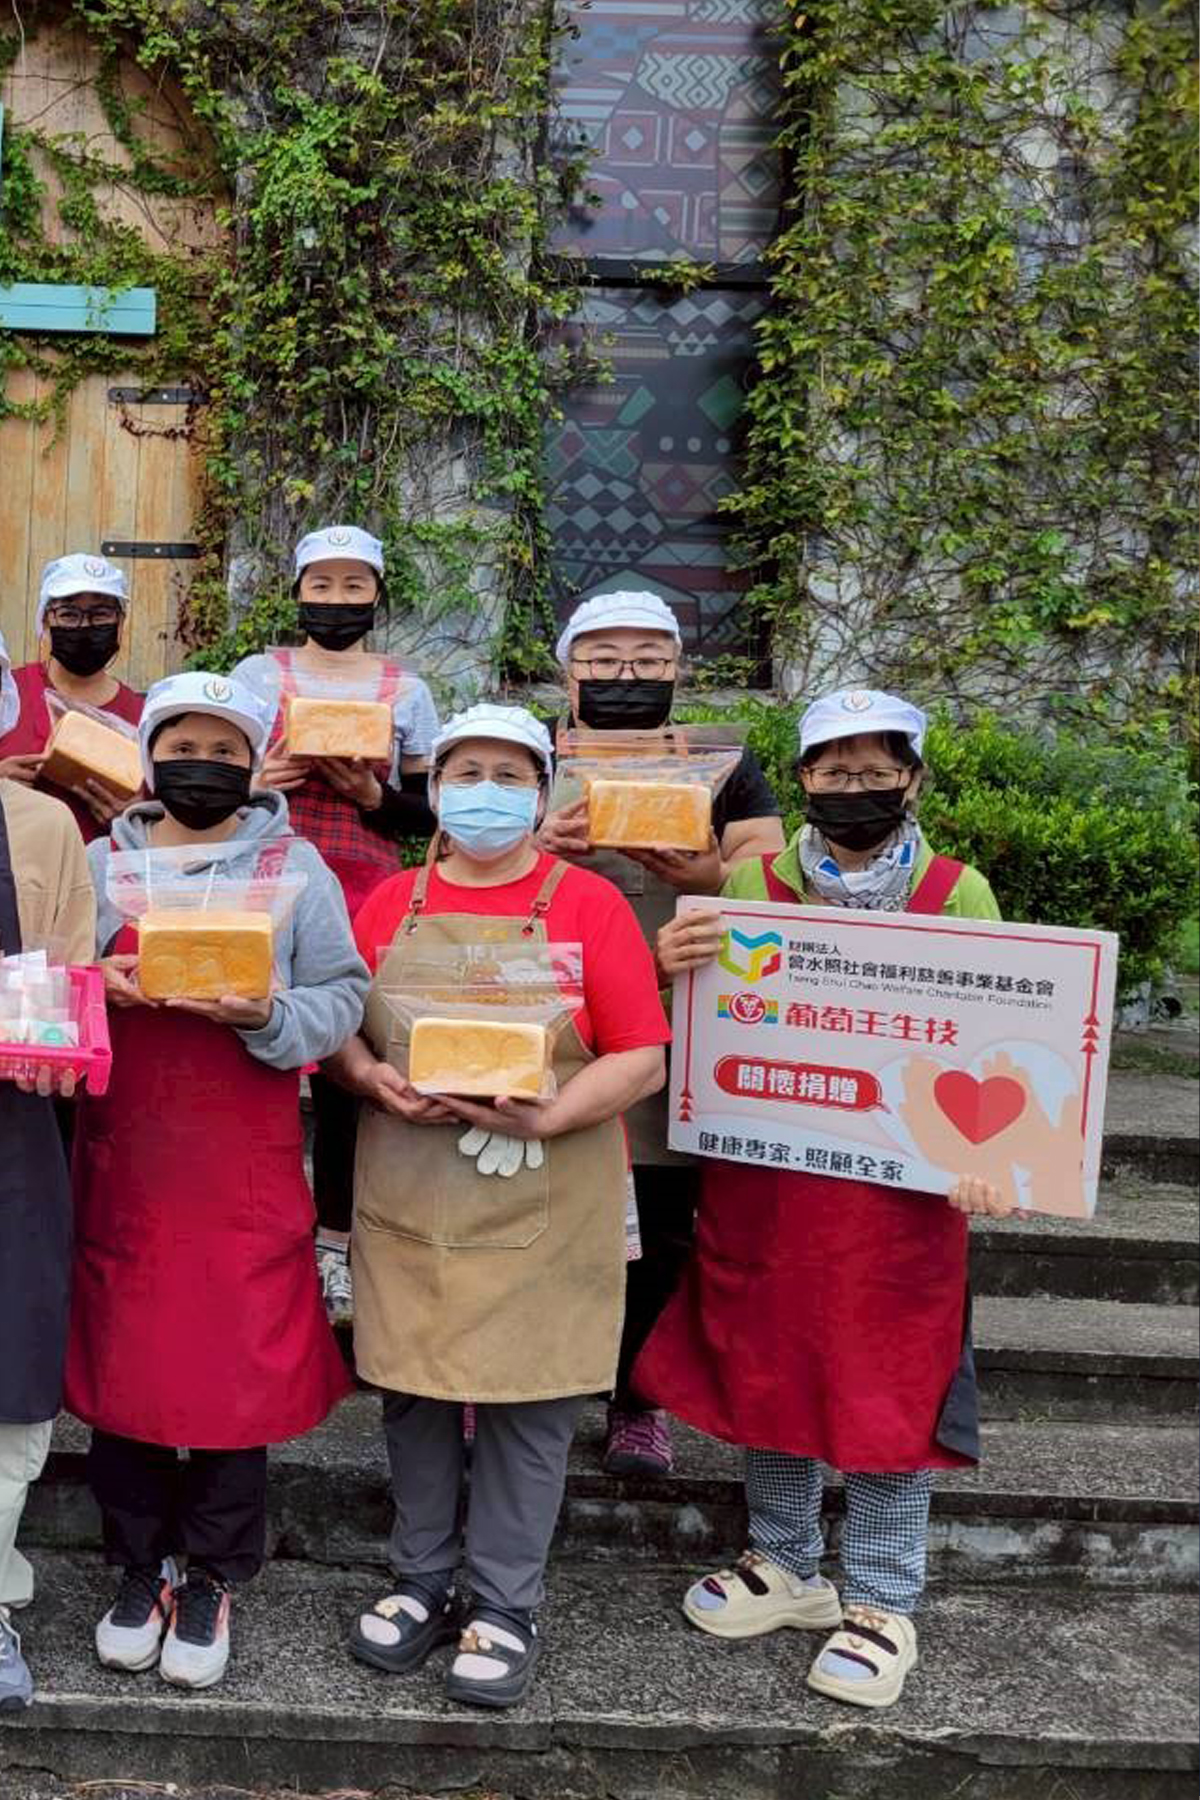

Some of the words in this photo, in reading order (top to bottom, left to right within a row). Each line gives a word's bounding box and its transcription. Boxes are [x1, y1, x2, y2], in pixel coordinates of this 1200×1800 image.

[788, 940, 842, 956] 財團法人
[880, 982, 924, 996] Welfare
[988, 994, 1052, 1009] Foundation
[784, 1001, 960, 1047] 葡萄王生技
[737, 1063, 859, 1105] 關懷捐贈
